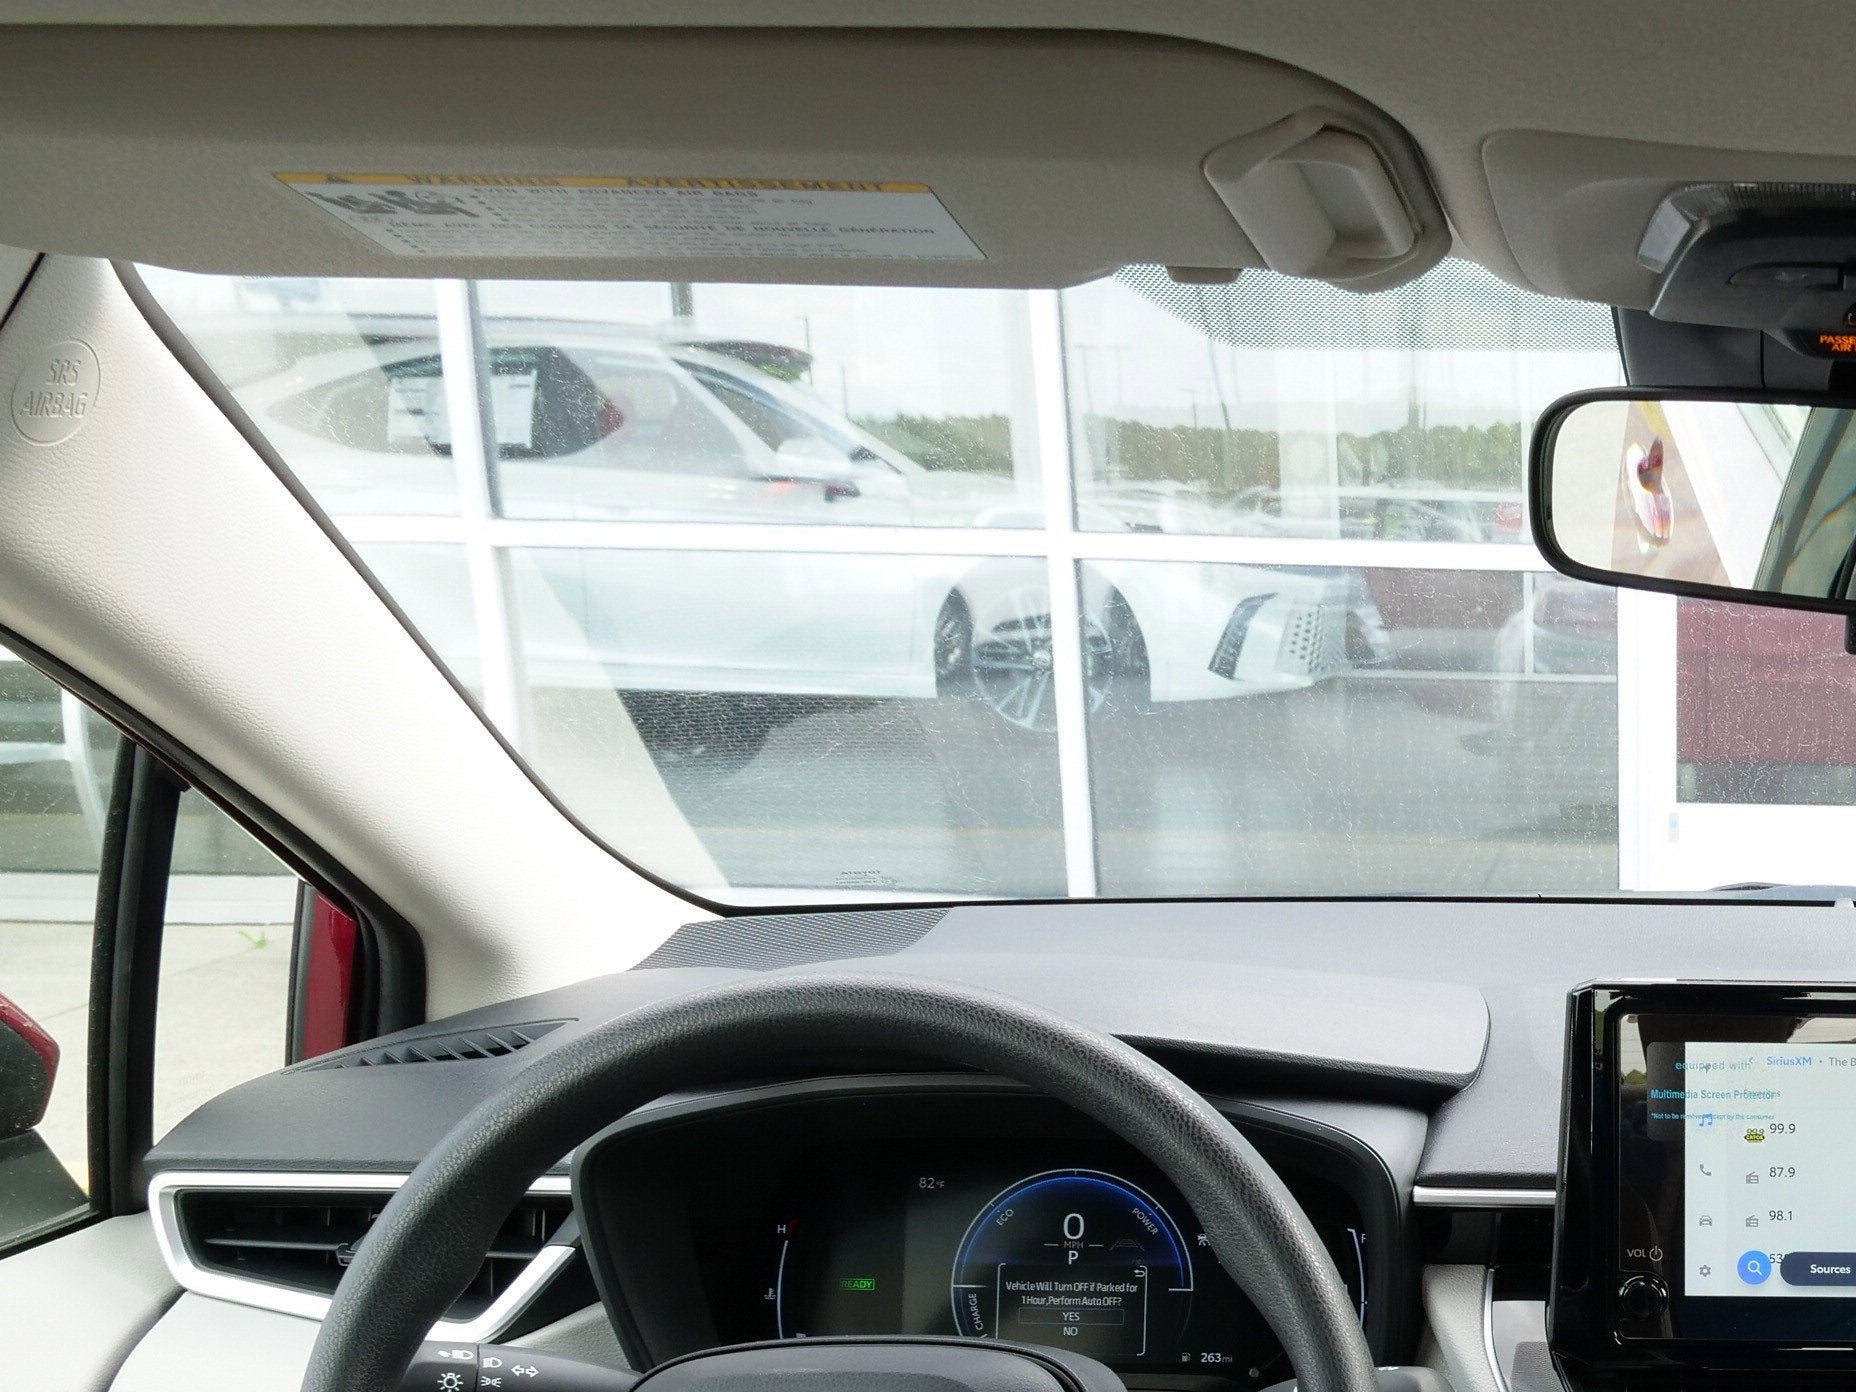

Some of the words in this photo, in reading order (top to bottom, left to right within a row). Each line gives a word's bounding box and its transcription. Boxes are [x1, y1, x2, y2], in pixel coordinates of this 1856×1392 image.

[1831, 344, 1851, 352] AIR
[45, 358, 82, 386] SRS
[19, 391, 88, 417] AIRBAG
[1675, 1061, 1725, 1072] equipped
[1729, 1061, 1751, 1070] with
[1766, 1056, 1812, 1066] SiriusXM
[1828, 1057, 1848, 1067] The
[1650, 1089, 1698, 1099] Multimedia
[1700, 1089, 1732, 1099] Screen
[1769, 1123, 1796, 1134] 99.9
[1769, 1167, 1796, 1178] 87.9
[996, 1208, 1014, 1226] ECO
[1768, 1210, 1793, 1221] 98.1
[1063, 1213, 1085, 1240] 0
[1132, 1207, 1159, 1236] POWER
[777, 1224, 786, 1234] H
[1064, 1241, 1084, 1249] MPH
[1068, 1250, 1079, 1265] P
[1626, 1248, 1646, 1258] VOL
[1810, 1263, 1851, 1275] Sources
[841, 1279, 873, 1289] READY
[1006, 1281, 1035, 1291] Vehicle
[1036, 1281, 1052, 1291] Will
[1054, 1282, 1072, 1291] Turn
[1073, 1282, 1089, 1292] OFF
[1089, 1282, 1095, 1291] if
[1096, 1282, 1125, 1292] Parked
[1125, 1283, 1138, 1293] for
[1082, 1296, 1102, 1306] Auto
[1102, 1296, 1122, 1306] OFF?
[968, 1293, 984, 1331] CHARGE
[1062, 1311, 1080, 1322] YES
[1063, 1326, 1078, 1336] NO
